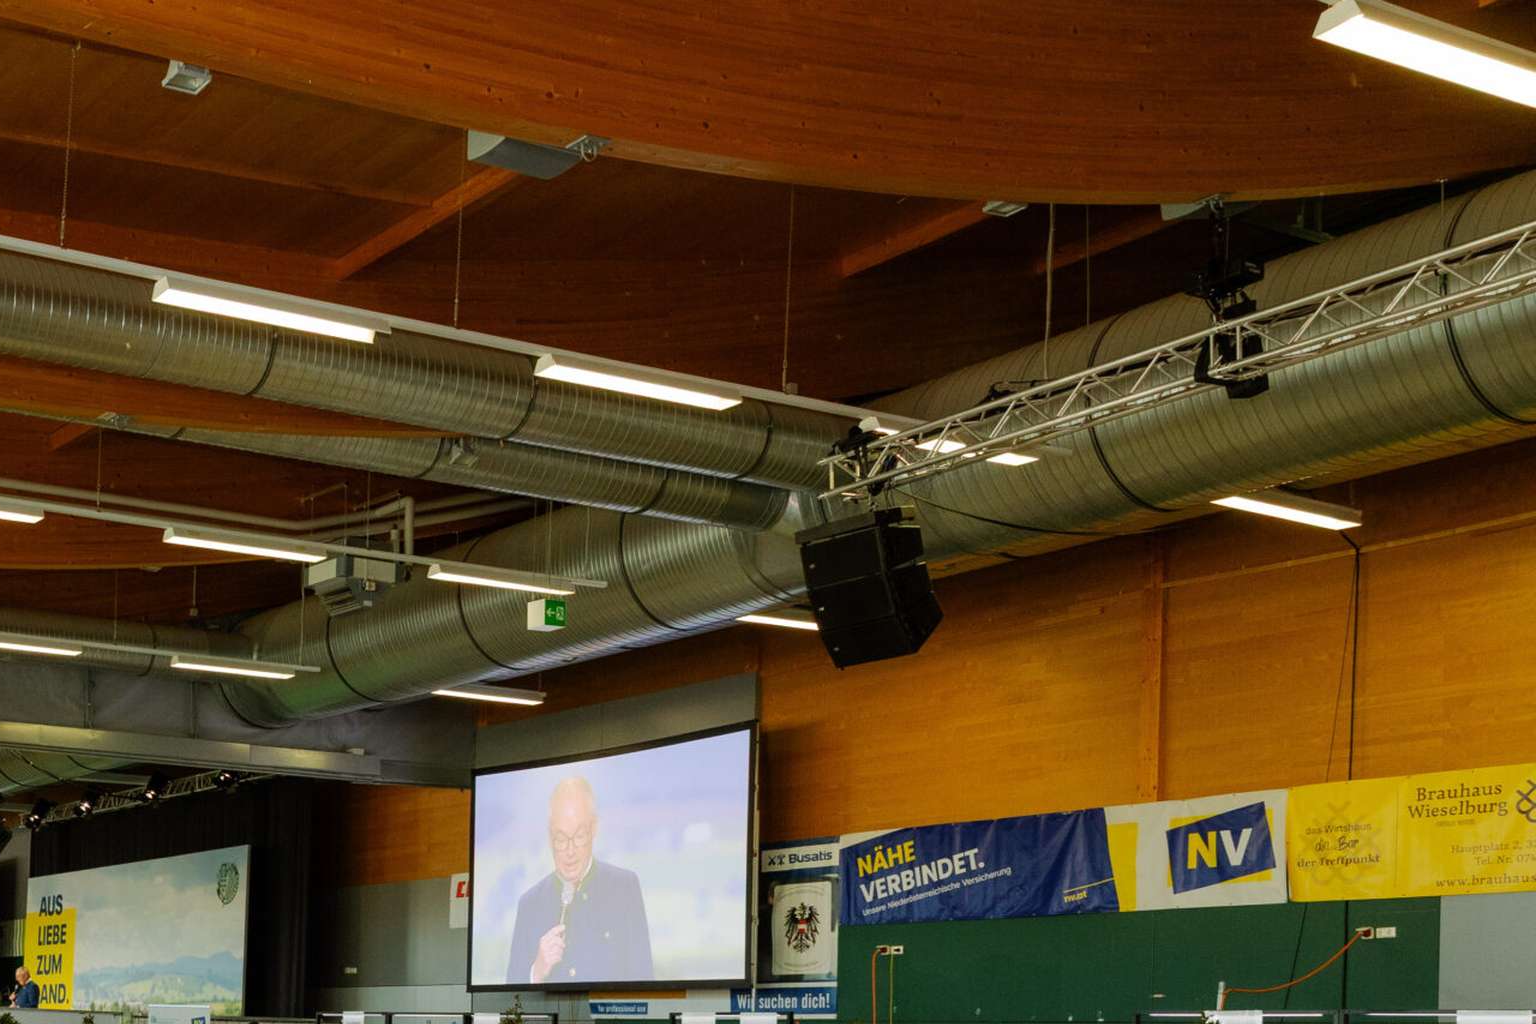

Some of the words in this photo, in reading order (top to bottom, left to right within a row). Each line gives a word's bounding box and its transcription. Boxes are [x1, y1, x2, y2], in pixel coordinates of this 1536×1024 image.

[1415, 783, 1503, 803] Brauhaus
[1407, 799, 1509, 820] Wieselburg
[1187, 827, 1253, 870] NV
[1336, 836, 1359, 851] Bar
[1451, 841, 1510, 855] Hauptplatz
[788, 850, 833, 865] Busatis
[856, 839, 916, 878] NÄHE
[1296, 856, 1317, 869] der
[1319, 853, 1381, 869] Treffpunkt
[859, 848, 985, 903] VERBINDET.
[962, 866, 1012, 887] Versicherung
[39, 894, 63, 917] AUS
[37, 923, 67, 947] LIEBE
[36, 954, 63, 976] ZUM
[39, 983, 69, 1005] AND.
[758, 993, 799, 1010] suchen
[800, 992, 831, 1009] dich!
